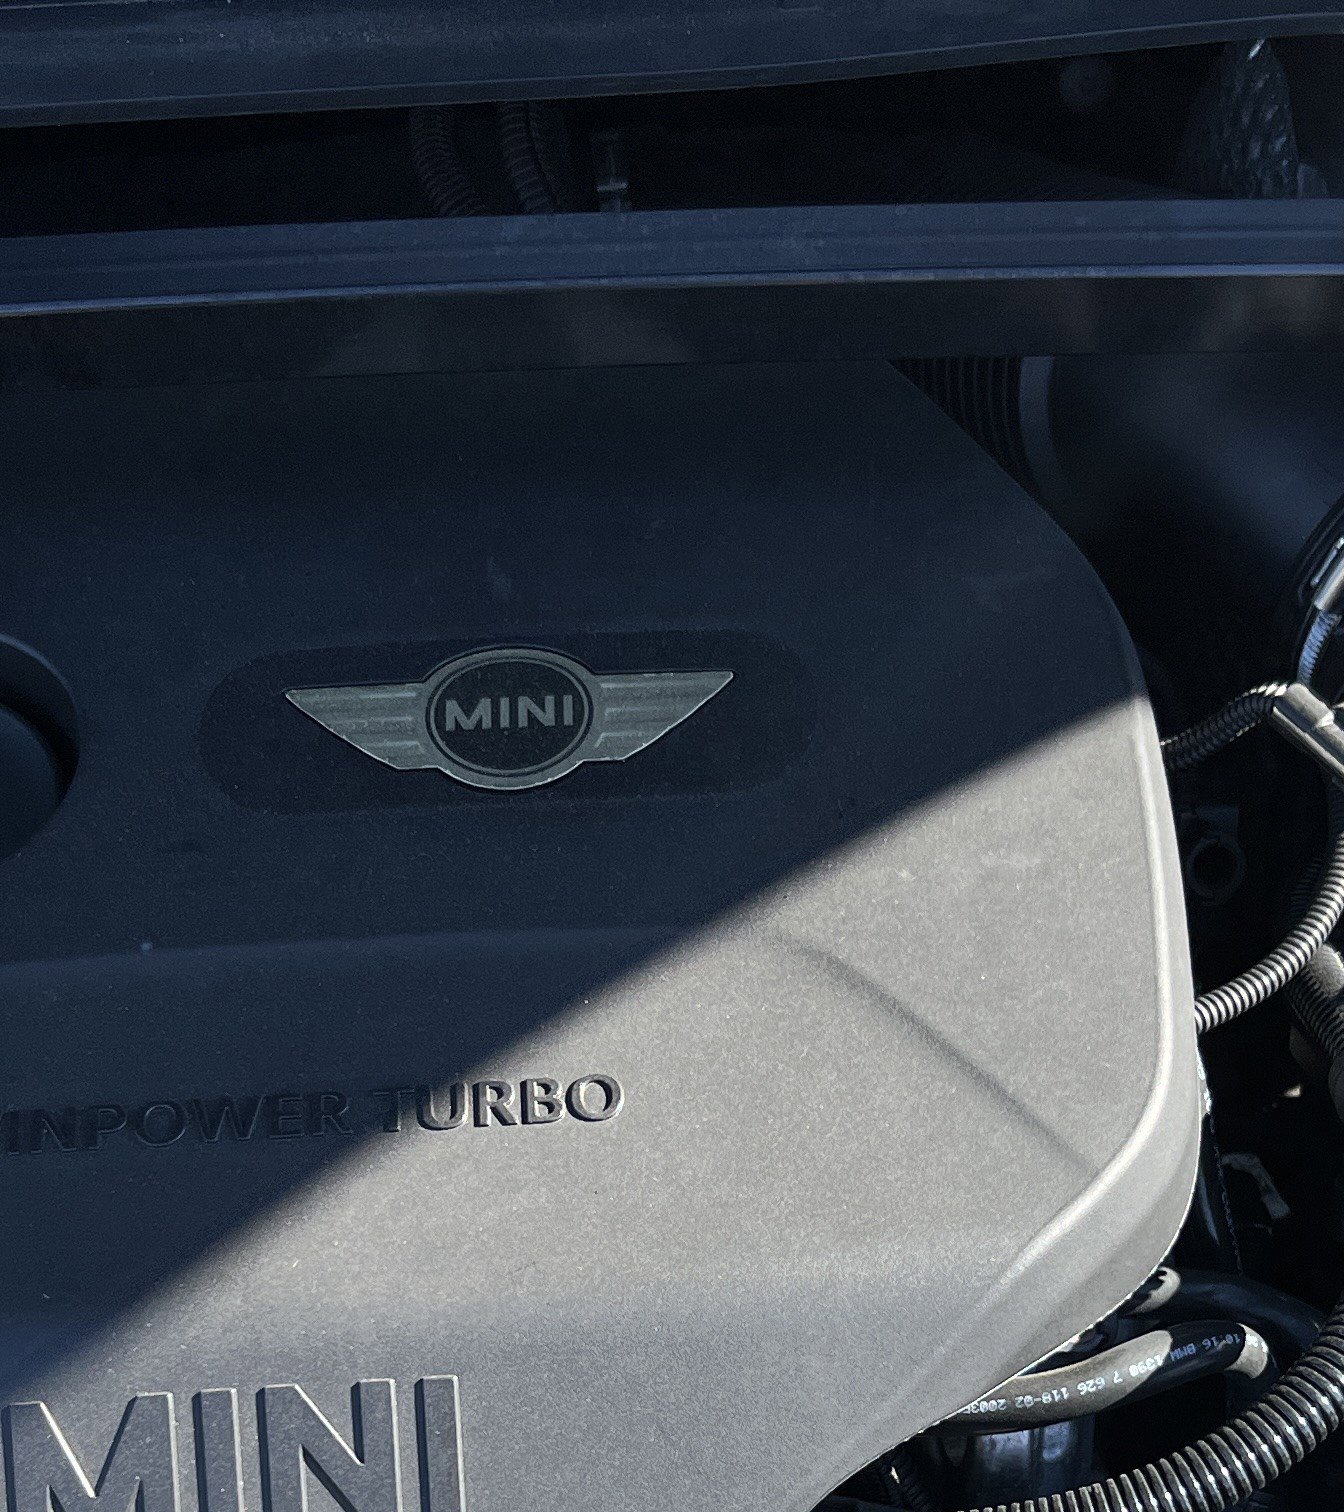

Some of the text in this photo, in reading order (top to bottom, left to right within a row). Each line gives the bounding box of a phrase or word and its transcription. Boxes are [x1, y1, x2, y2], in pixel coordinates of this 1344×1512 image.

[445, 693, 575, 732] MINI
[375, 1072, 626, 1135] TURBO
[1170, 1342, 1197, 1362] BMW
[1076, 1379, 1106, 1396] 626
[1113, 1371, 1123, 1385] 7
[1015, 1386, 1070, 1408] 118-02
